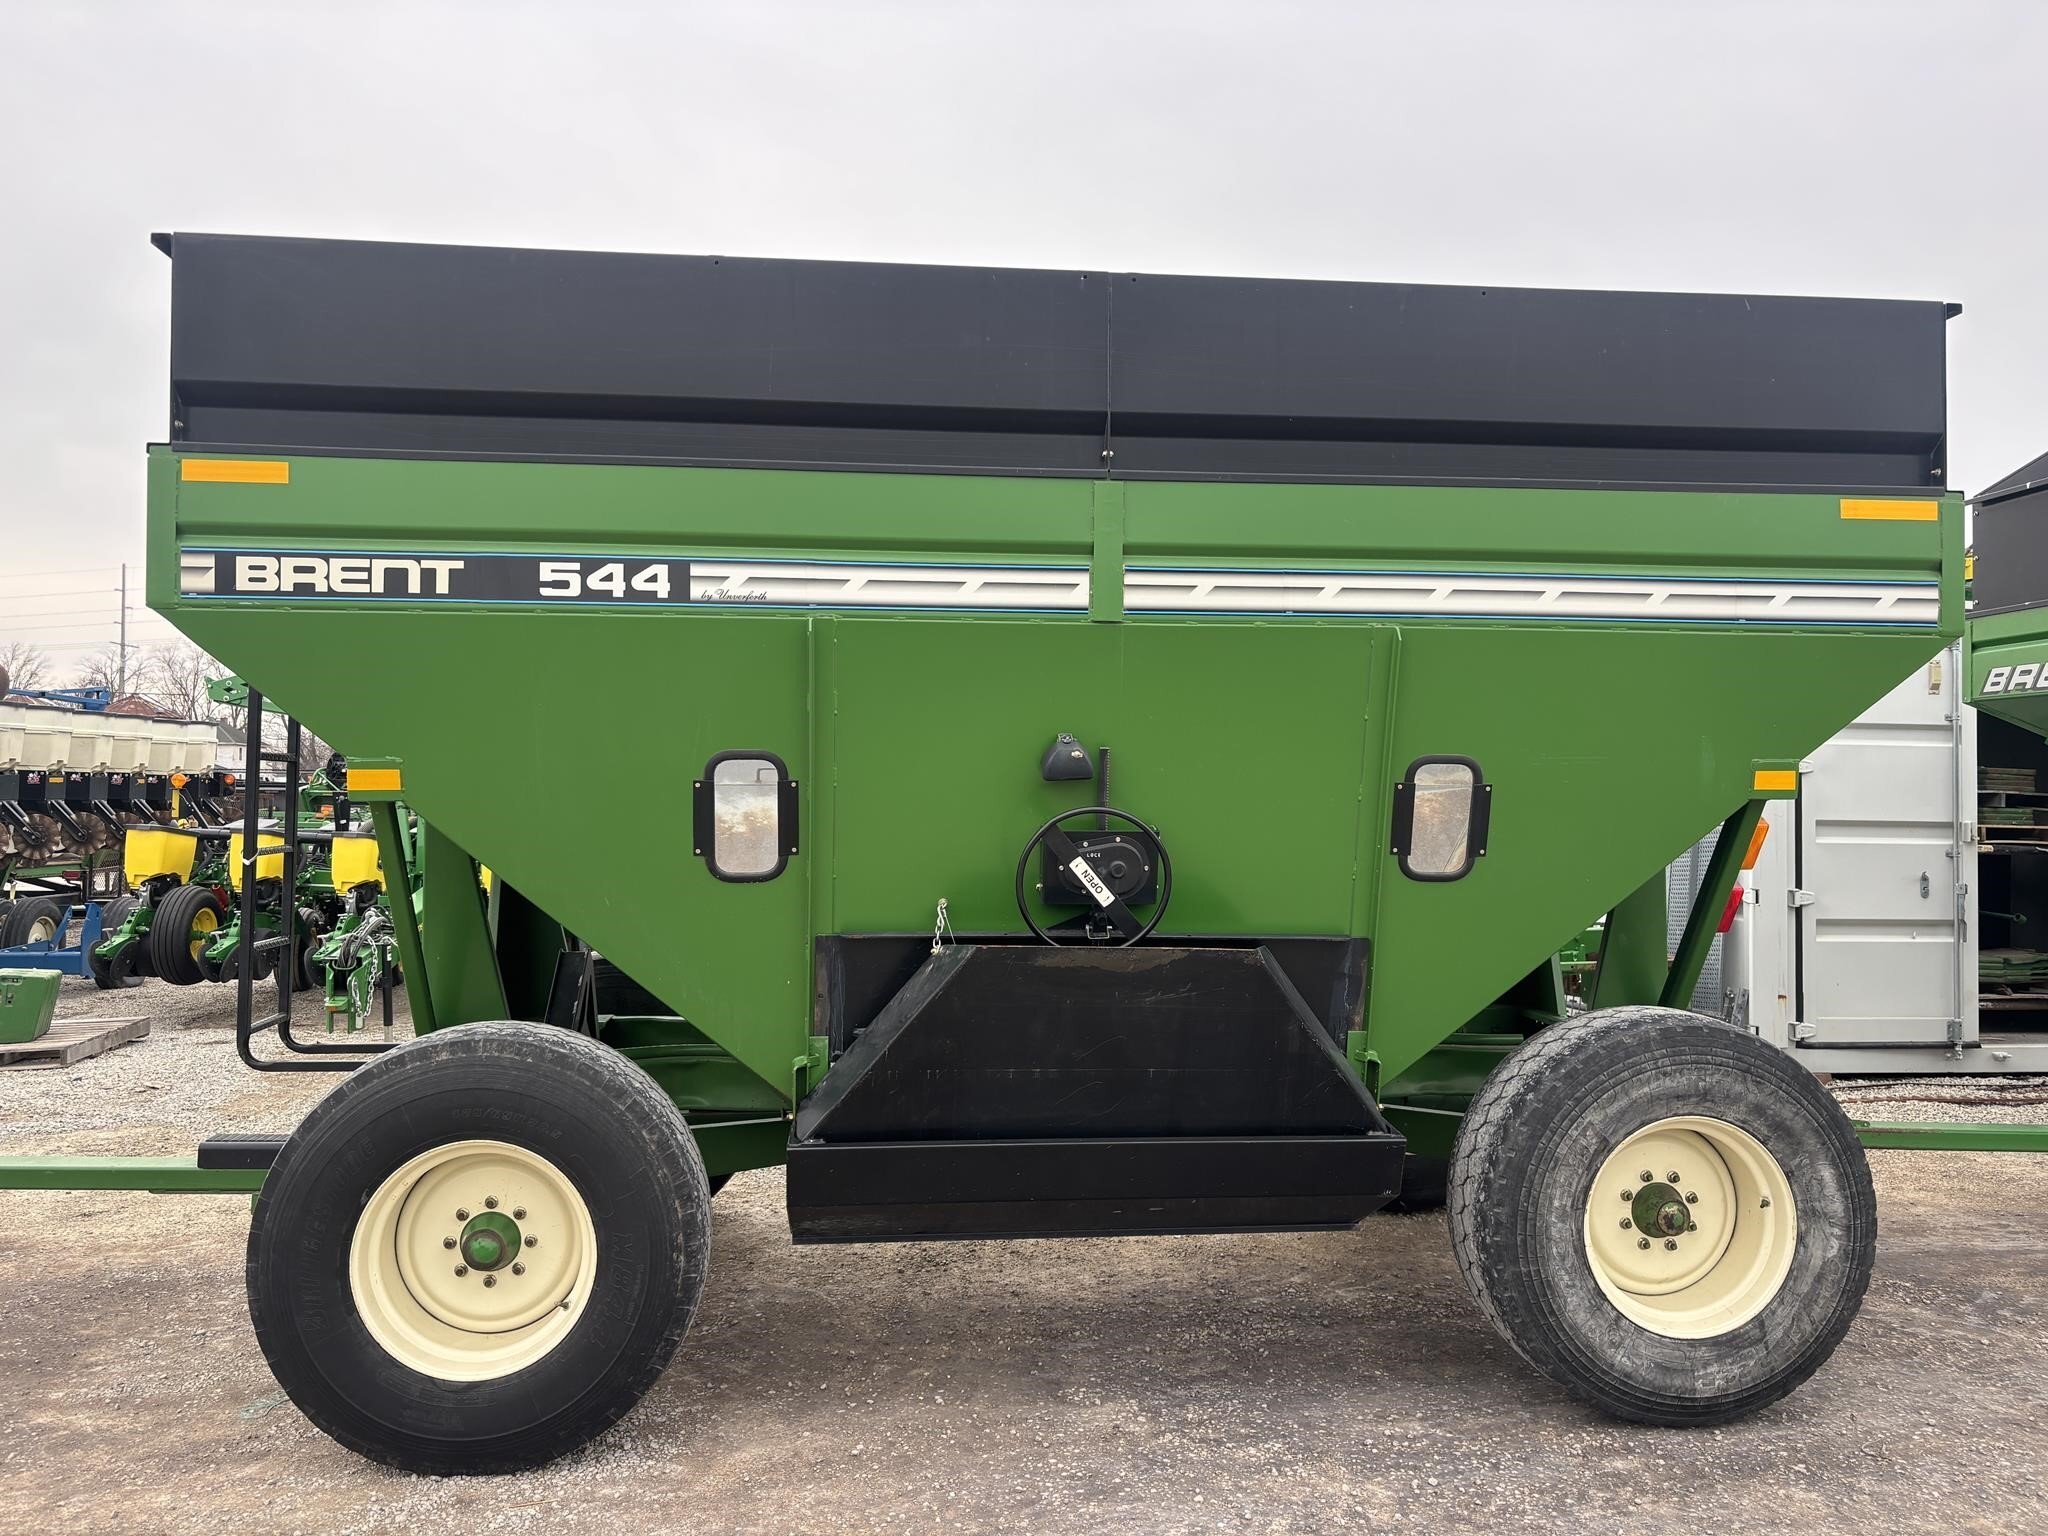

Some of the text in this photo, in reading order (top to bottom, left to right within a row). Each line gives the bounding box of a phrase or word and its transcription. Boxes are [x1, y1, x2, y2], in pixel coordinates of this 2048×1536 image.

[235, 555, 671, 599] BRENT 544
[701, 589, 713, 601] by
[1081, 869, 1103, 894] OPEN
